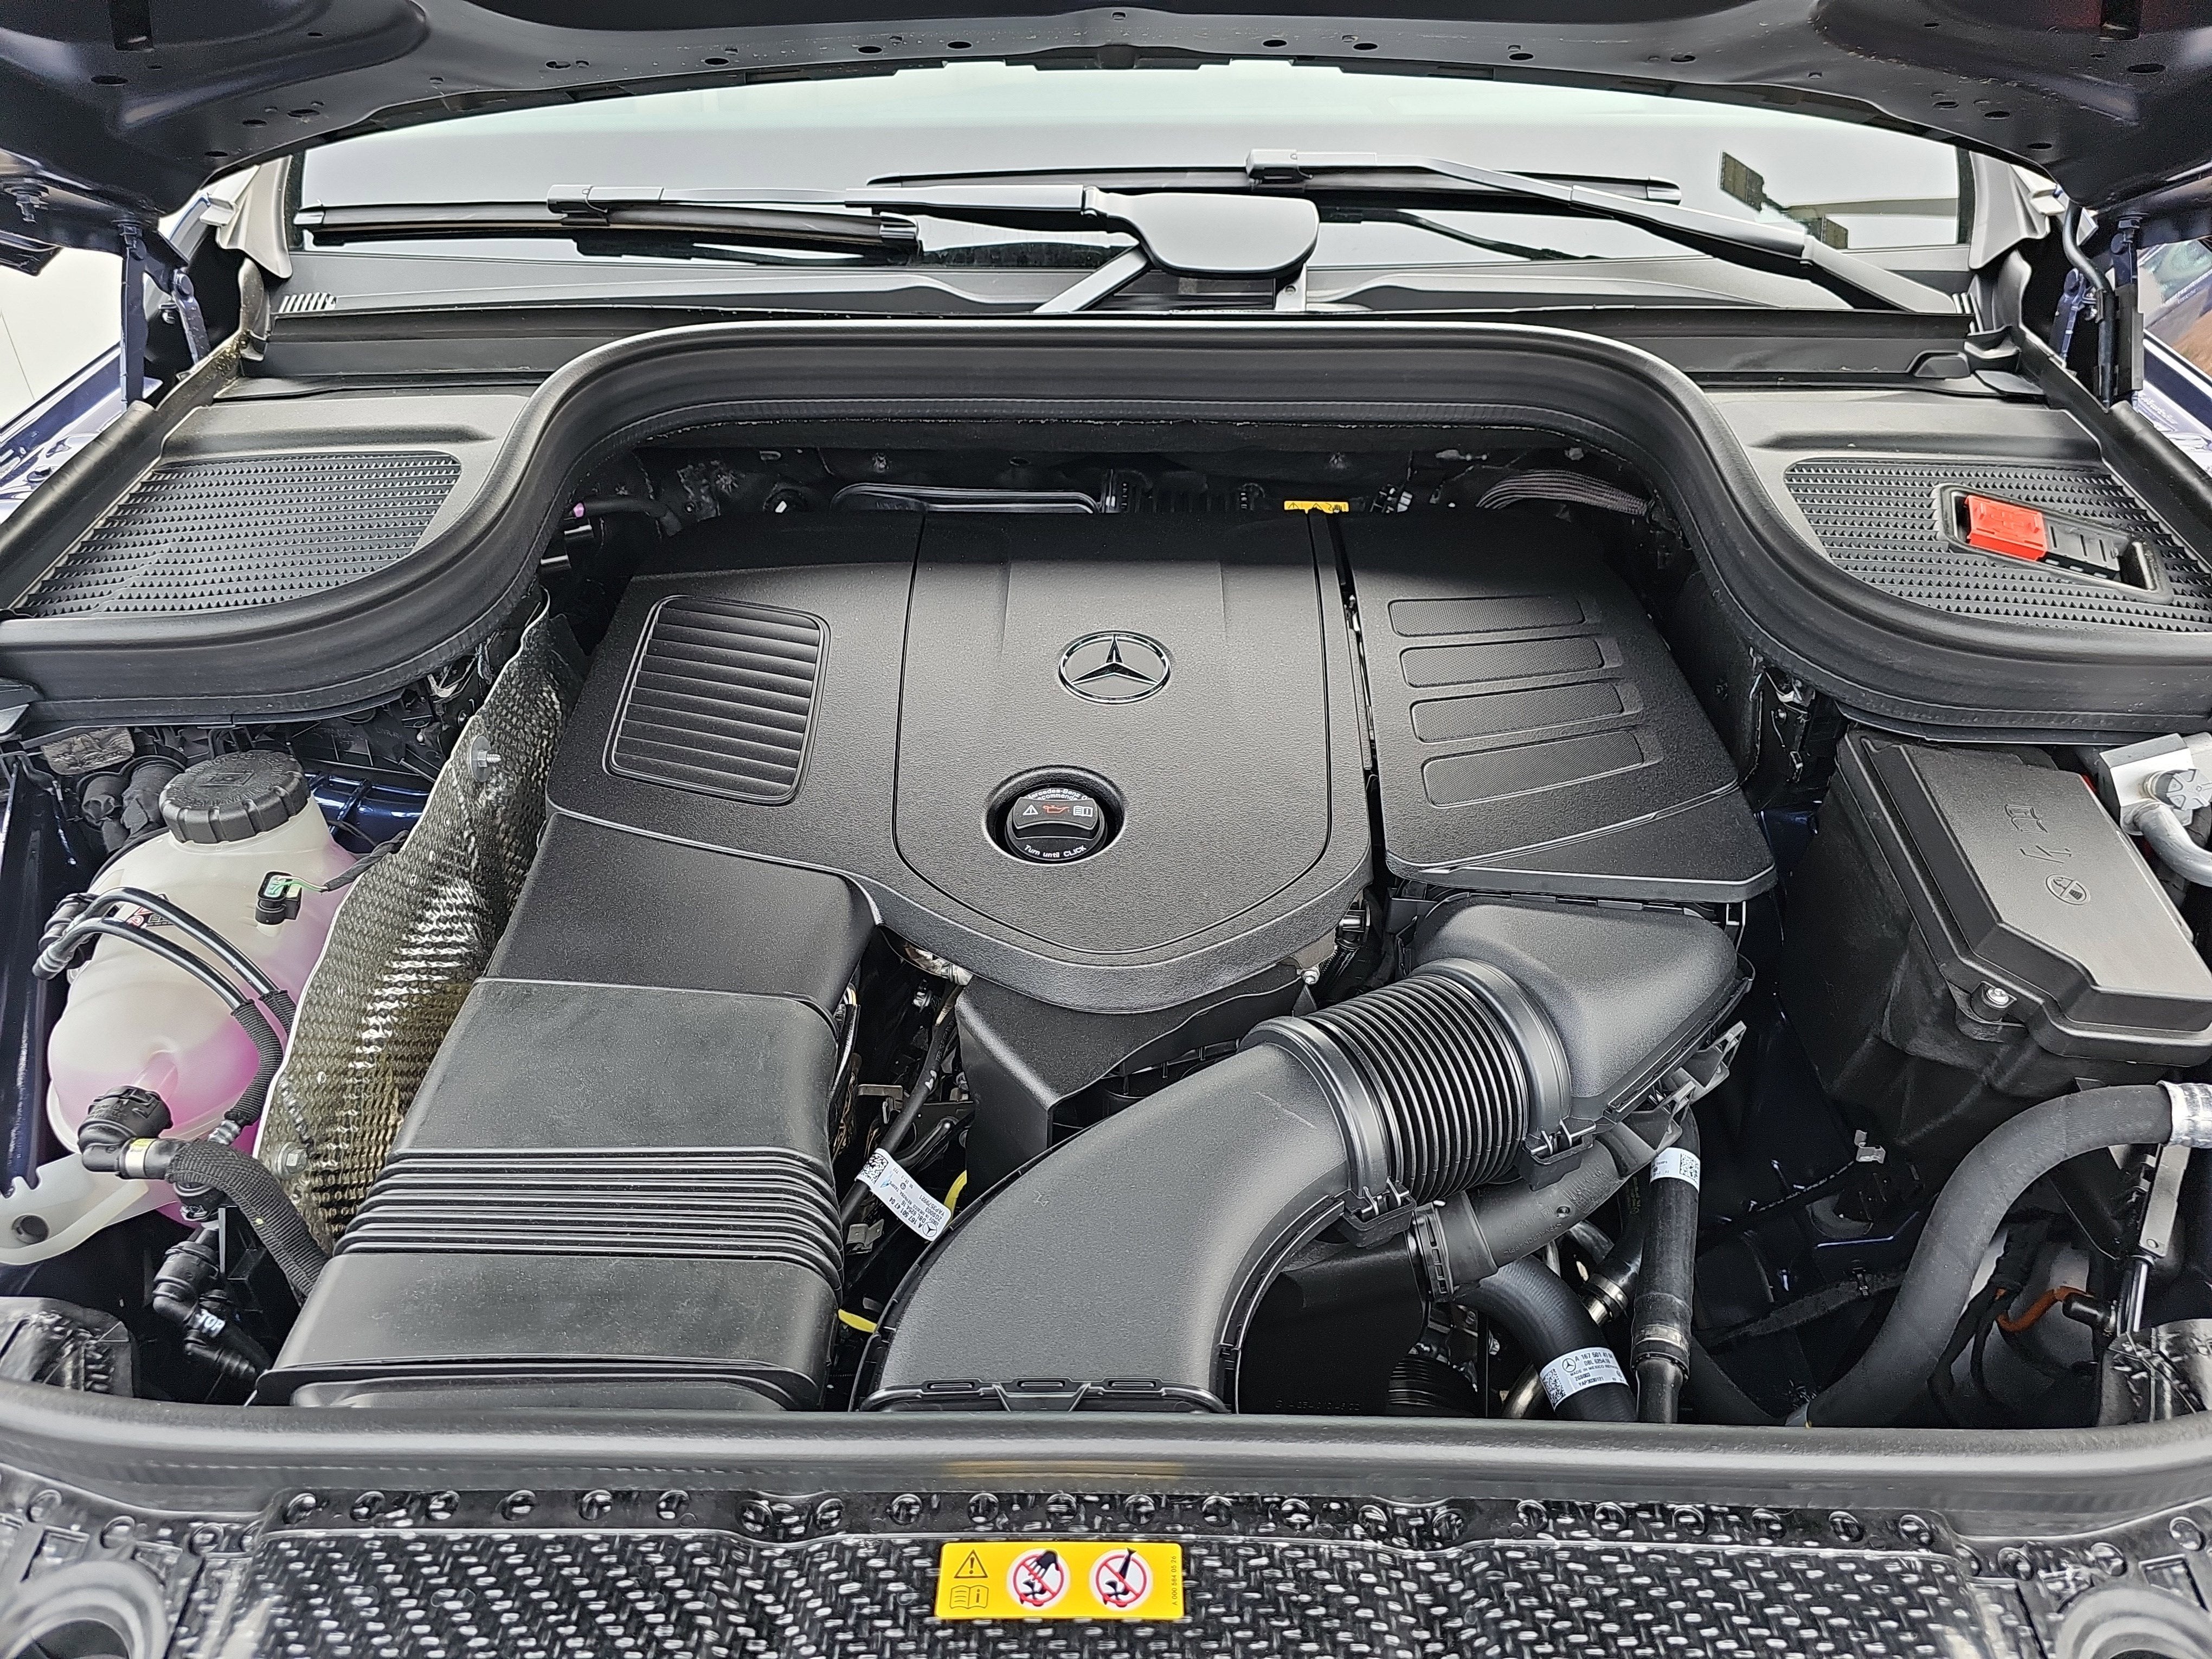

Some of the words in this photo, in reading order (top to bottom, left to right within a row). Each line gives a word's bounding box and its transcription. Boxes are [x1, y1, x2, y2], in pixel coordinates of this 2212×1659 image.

[1024, 844, 1040, 856] Turn
[1063, 845, 1087, 857] CLICK
[900, 1208, 910, 1218] 501
[916, 1213, 926, 1223] DBL
[908, 1216, 917, 1225] 167
[198, 1308, 226, 1331] TOP
[1171, 1565, 1176, 1573] 05
